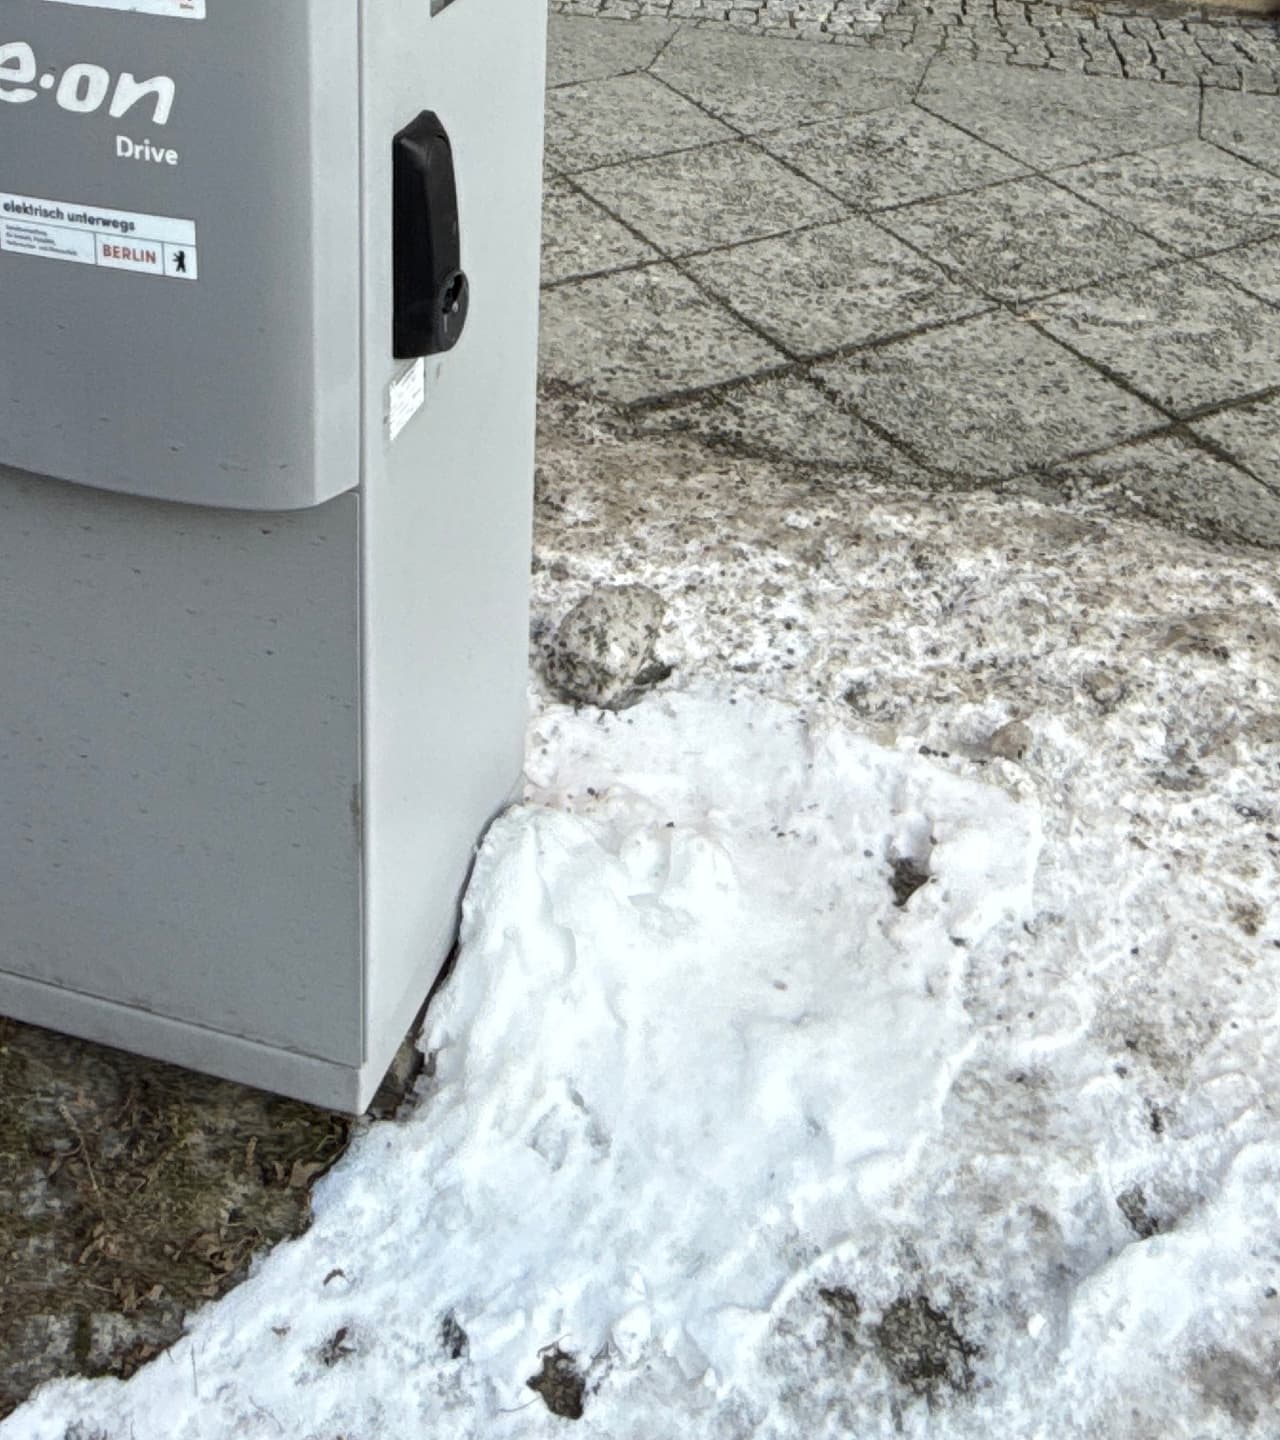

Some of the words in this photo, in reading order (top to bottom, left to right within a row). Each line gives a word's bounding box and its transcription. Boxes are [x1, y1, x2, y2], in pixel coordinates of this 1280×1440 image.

[116, 135, 179, 166] Drive
[2, 200, 65, 221] elektrisch
[67, 211, 136, 233] unterwegs
[103, 244, 157, 264] BERLIN
